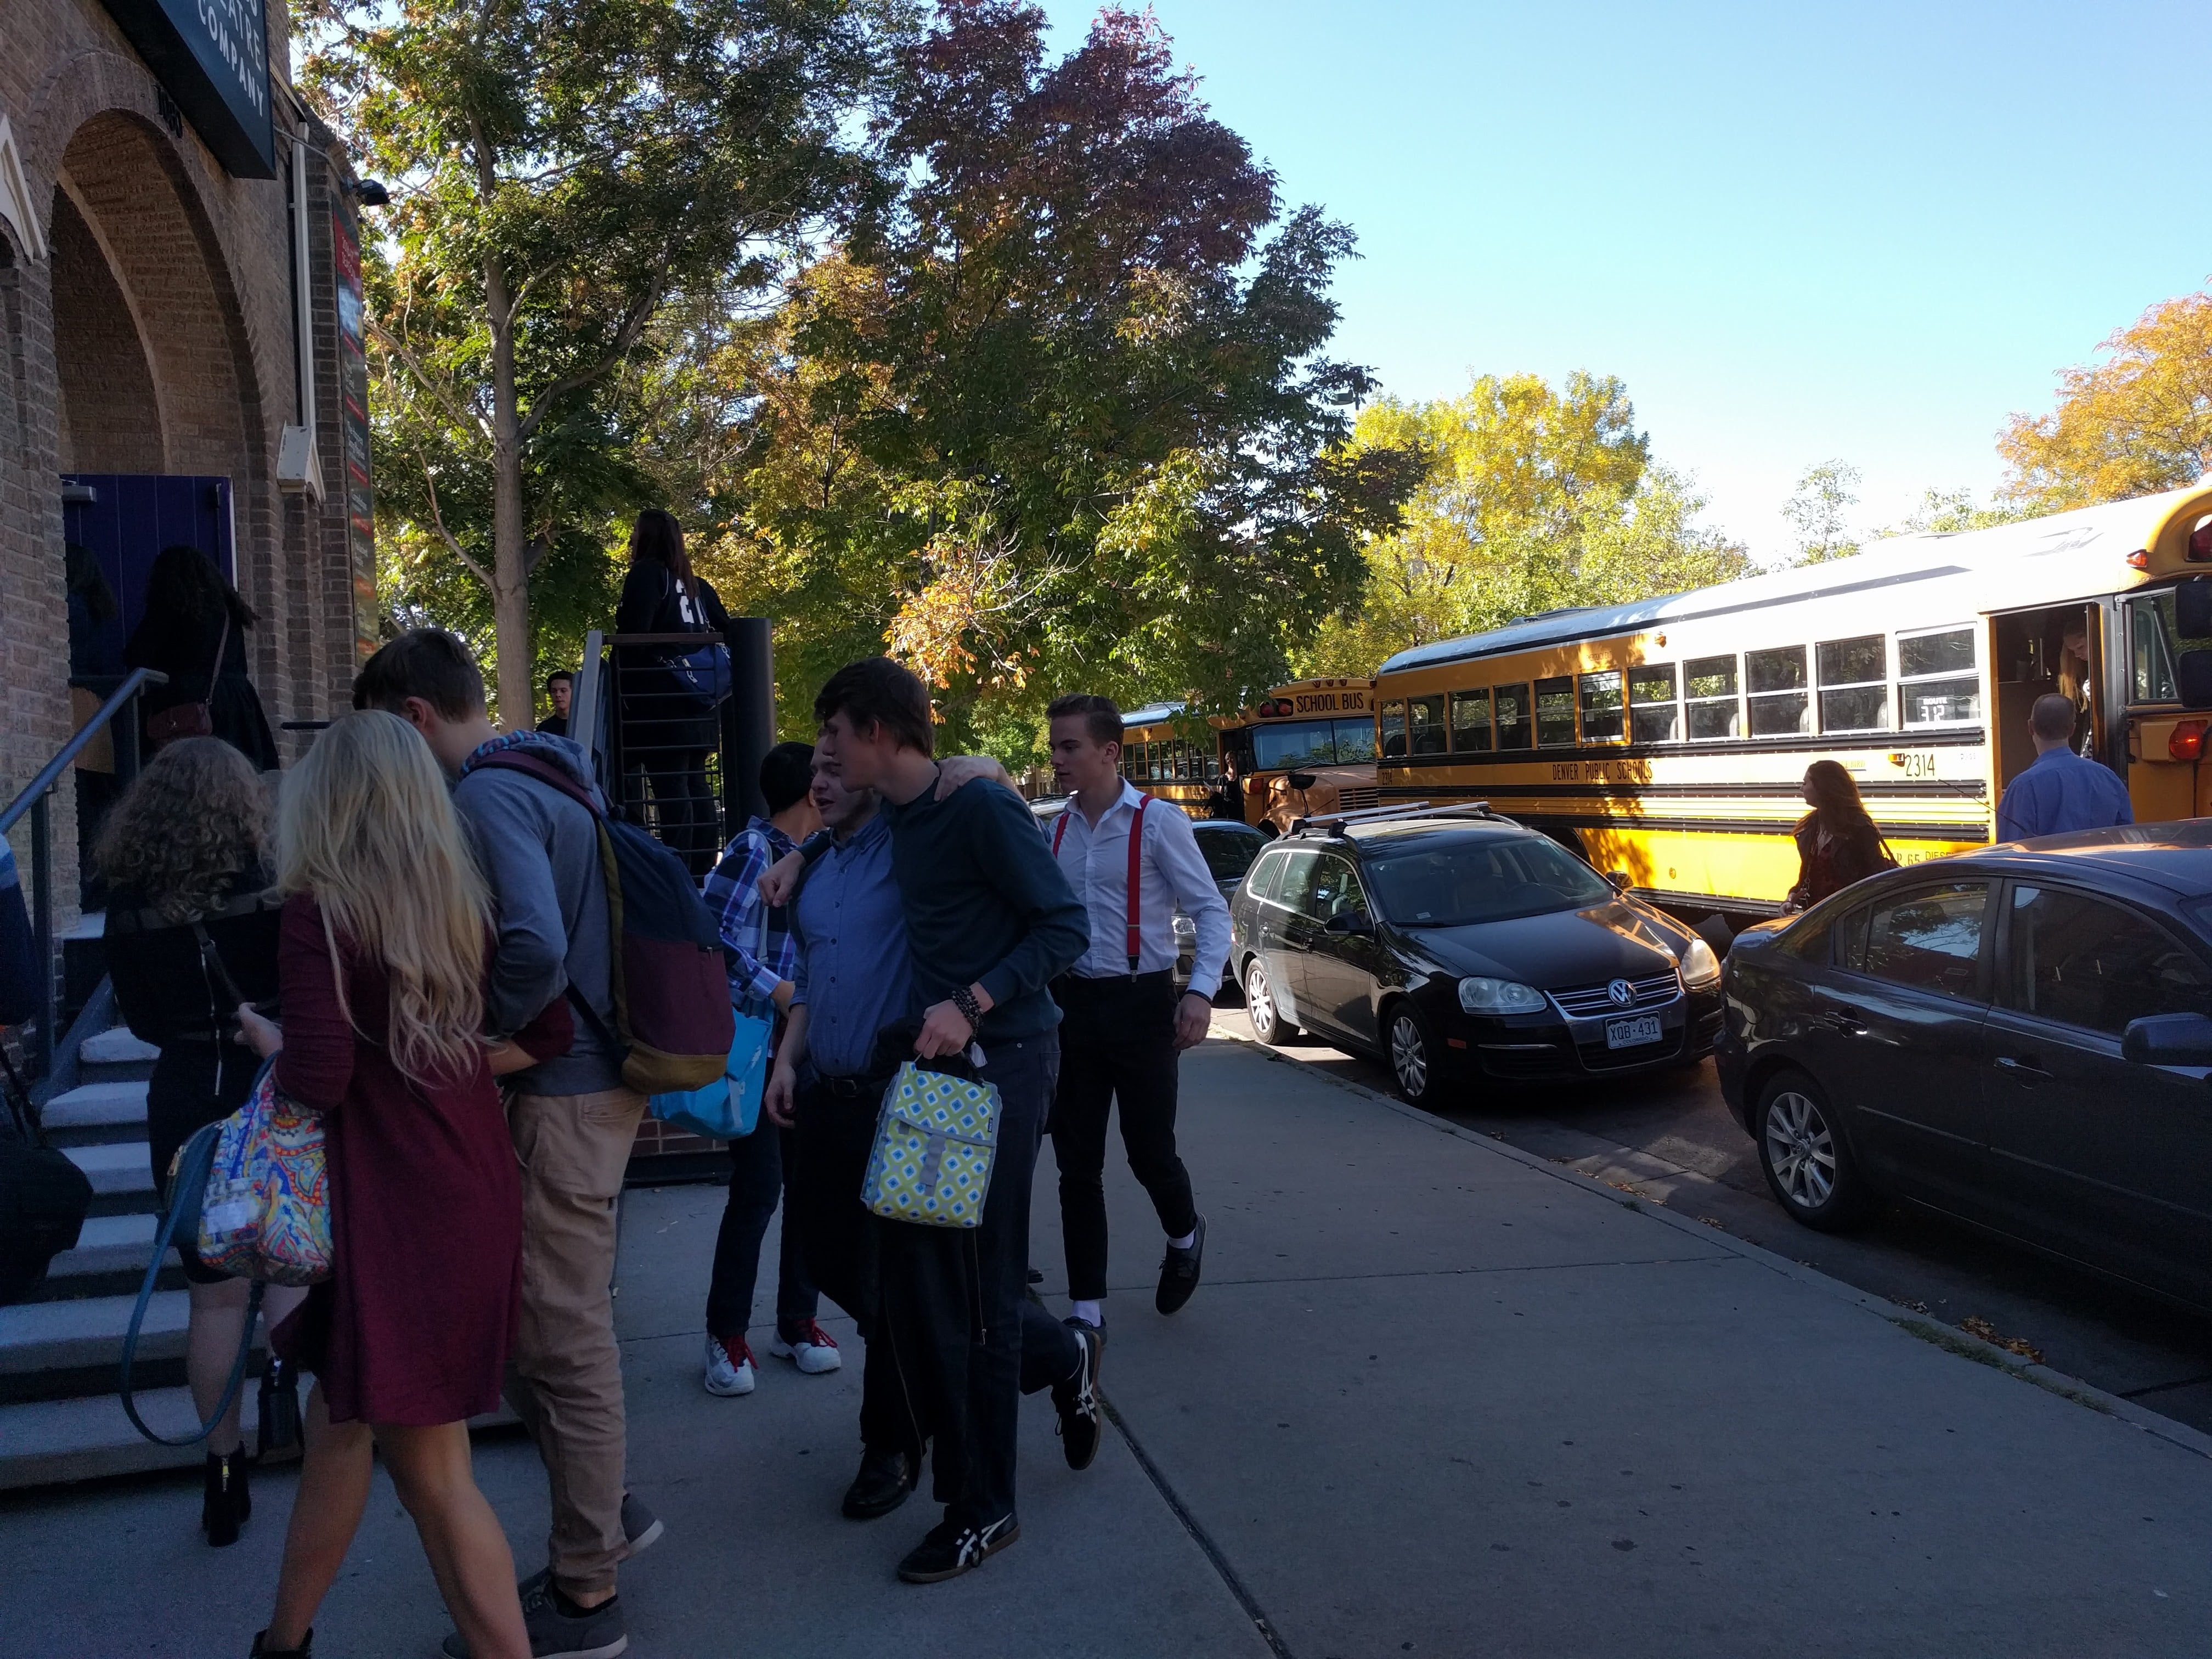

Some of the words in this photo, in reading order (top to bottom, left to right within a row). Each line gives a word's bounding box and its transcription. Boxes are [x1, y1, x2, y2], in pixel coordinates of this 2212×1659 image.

[198, 0, 263, 117] COMPANY
[1296, 694, 1339, 713] SCHOOL
[1341, 692, 1364, 709] BUS
[1923, 697, 1948, 705] ROUTE
[1552, 763, 1578, 780] DENVER
[1585, 762, 1610, 780] PUBLIC
[1616, 761, 1653, 780] SCHOOLS
[1905, 754, 1936, 776] 2314
[1622, 1036, 1649, 1045] COLORADO
